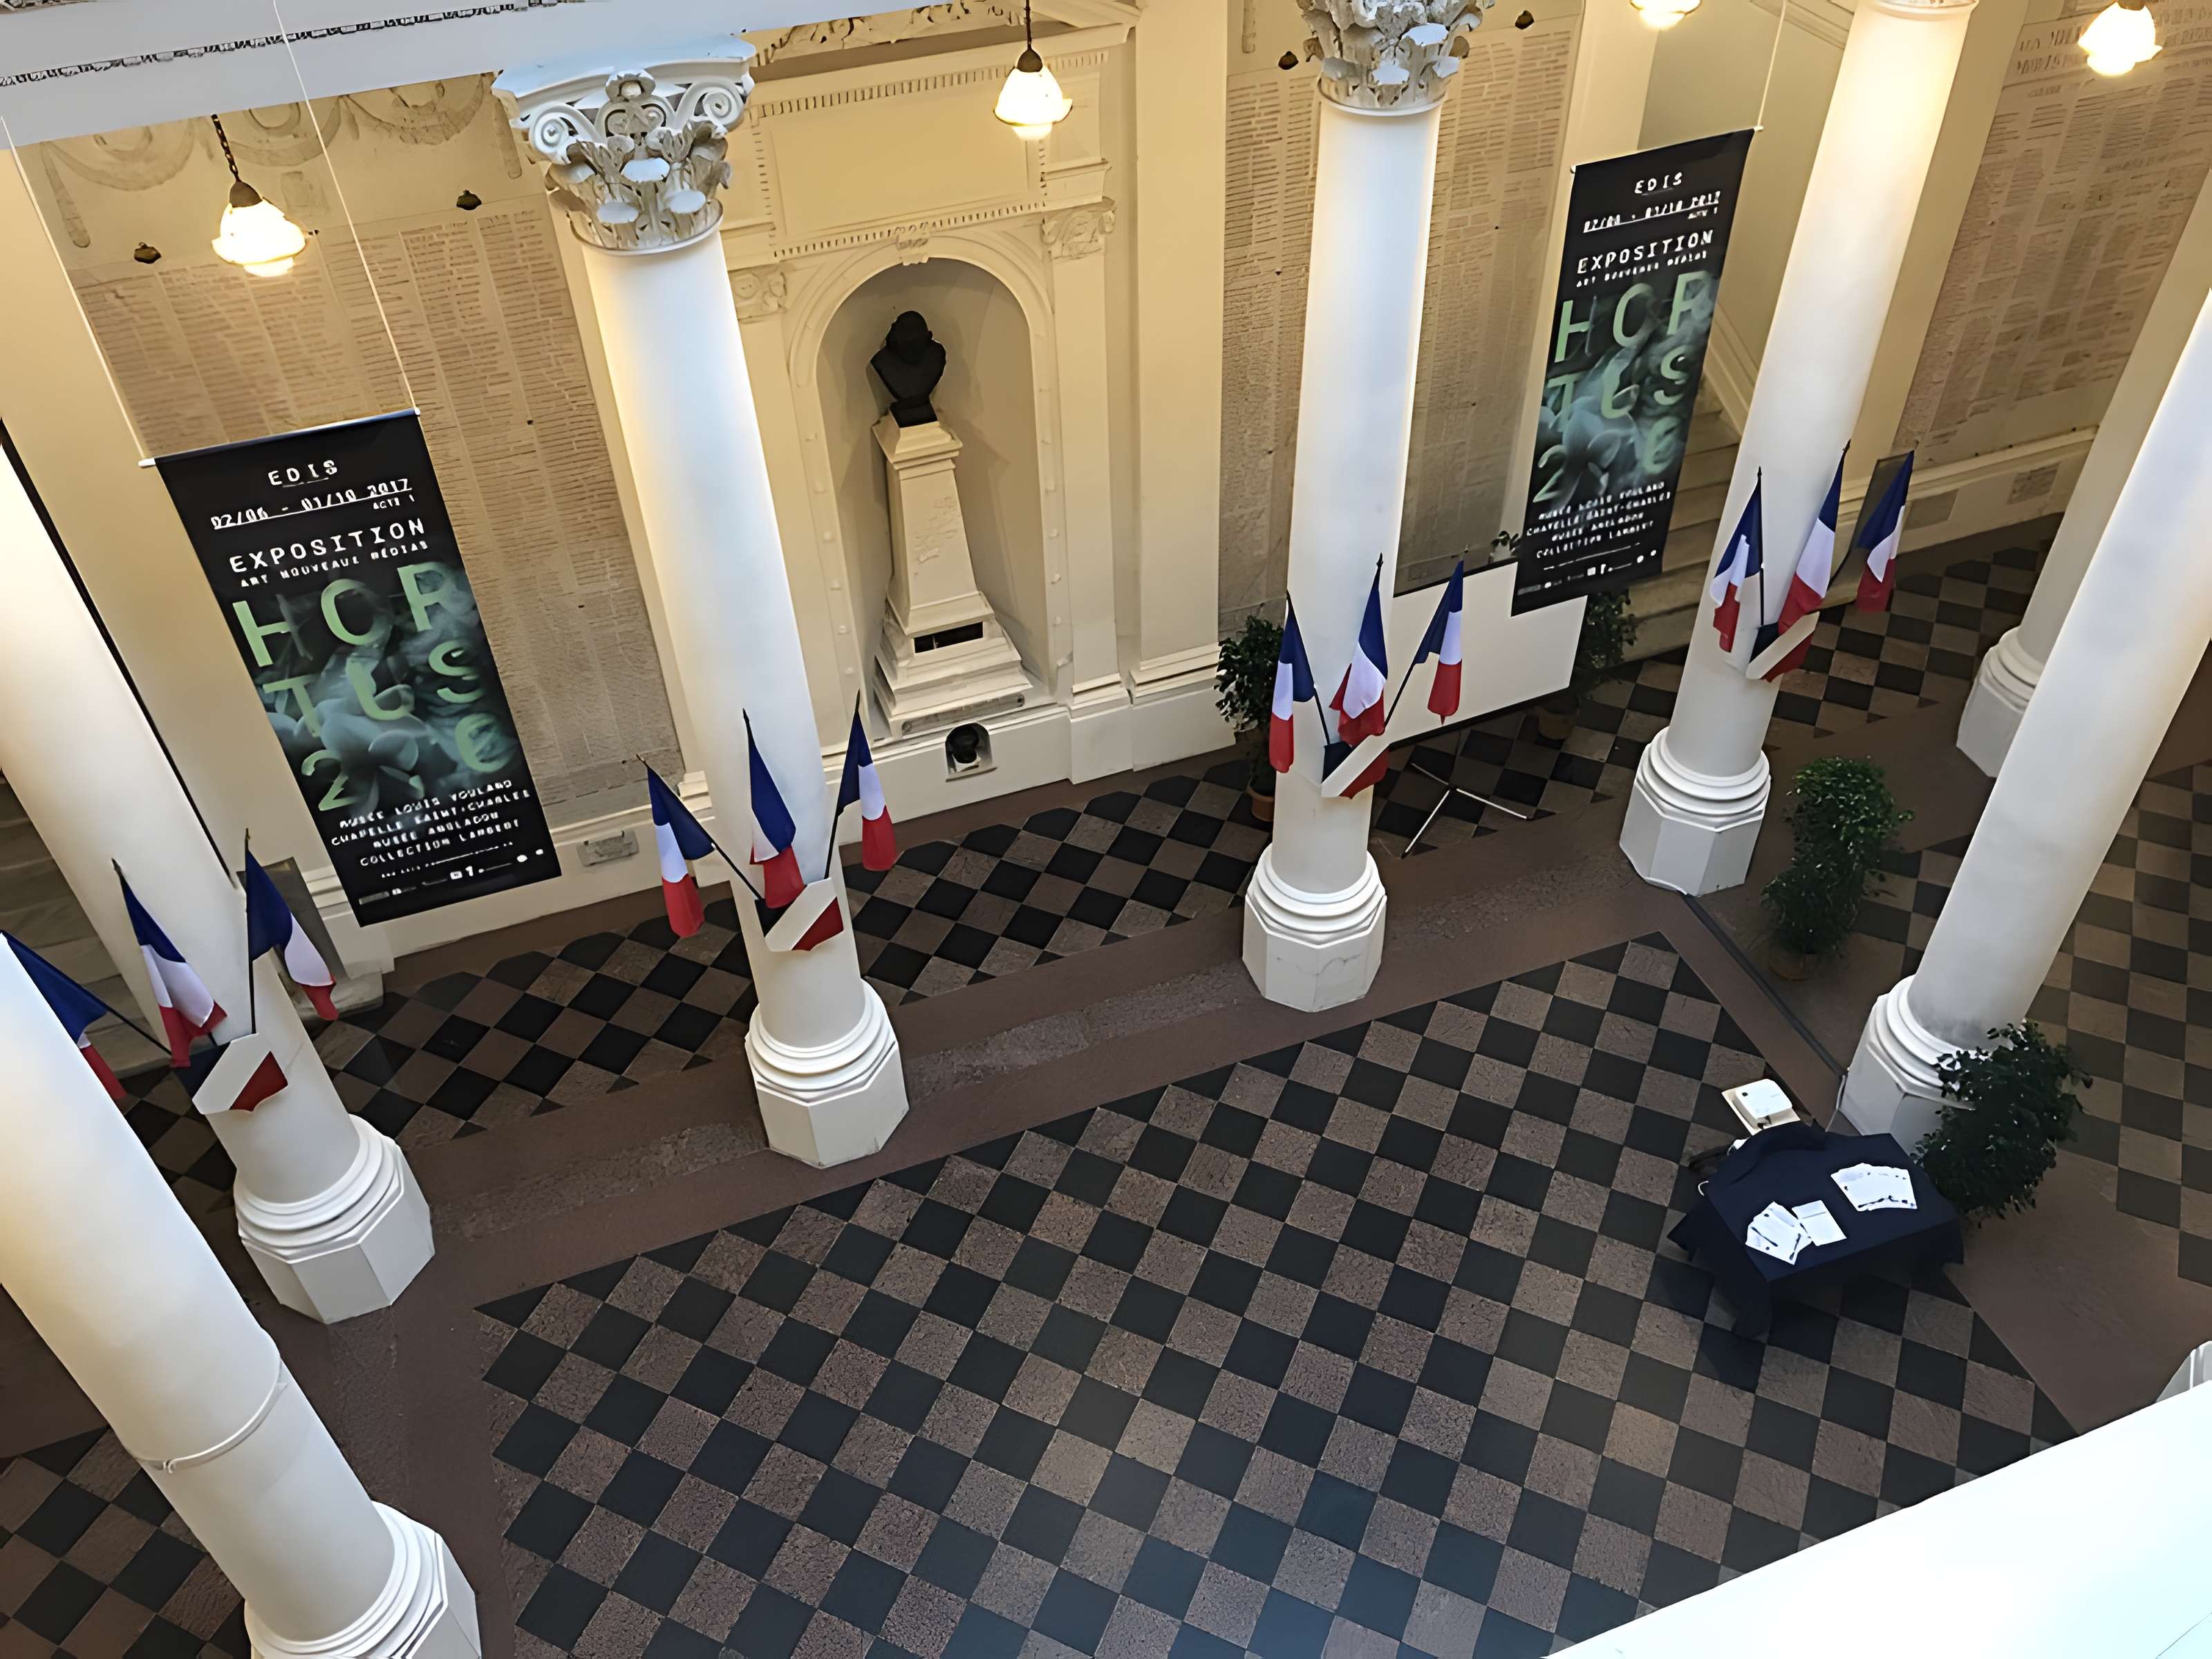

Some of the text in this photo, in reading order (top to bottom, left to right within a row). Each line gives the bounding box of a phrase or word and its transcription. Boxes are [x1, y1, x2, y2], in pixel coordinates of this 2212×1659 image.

[1634, 172, 1683, 194] EDIS
[1577, 229, 1714, 274] EXPOSITION
[268, 460, 337, 486] EDIS
[229, 518, 424, 573] EXPOSITION
